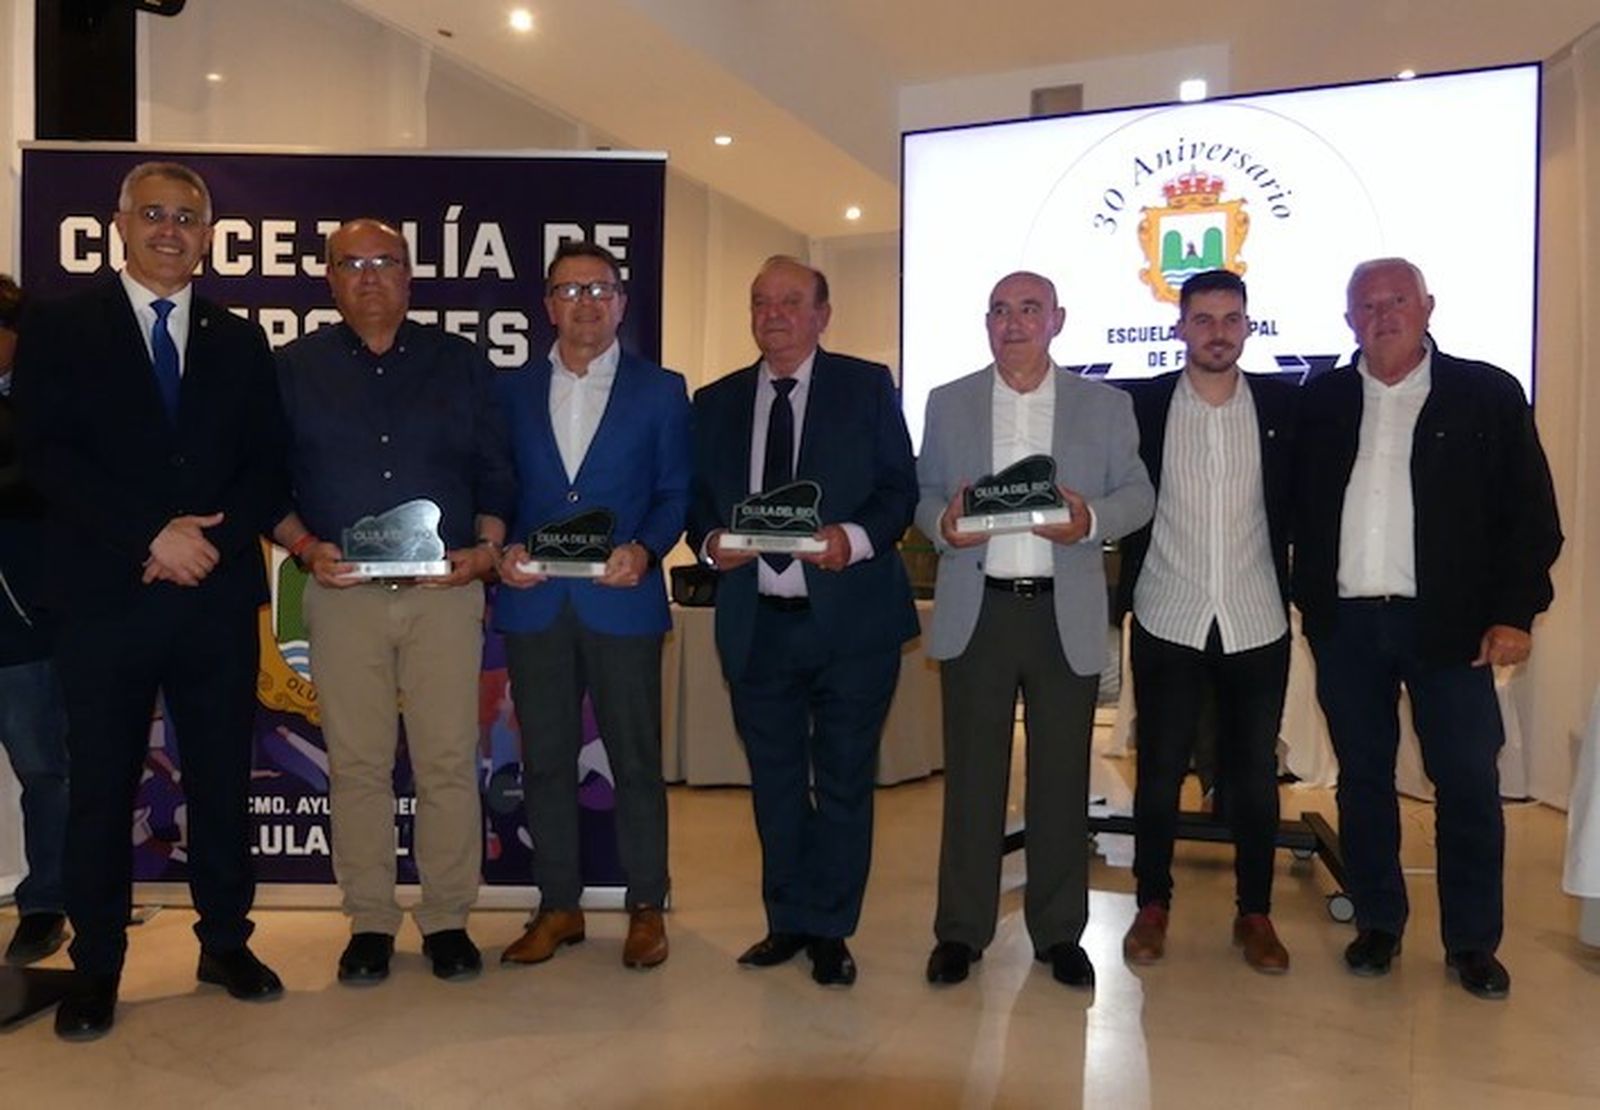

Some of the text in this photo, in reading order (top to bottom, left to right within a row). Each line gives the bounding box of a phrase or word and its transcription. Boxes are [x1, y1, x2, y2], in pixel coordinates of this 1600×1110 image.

[1093, 137, 1291, 234] 30 Aniversario
[60, 205, 515, 278] CCEJLÍA
[1107, 326, 1178, 344] ESCUELA
[1148, 350, 1168, 367] DE
[288, 677, 318, 702] OLU
[251, 825, 331, 855] ULA
